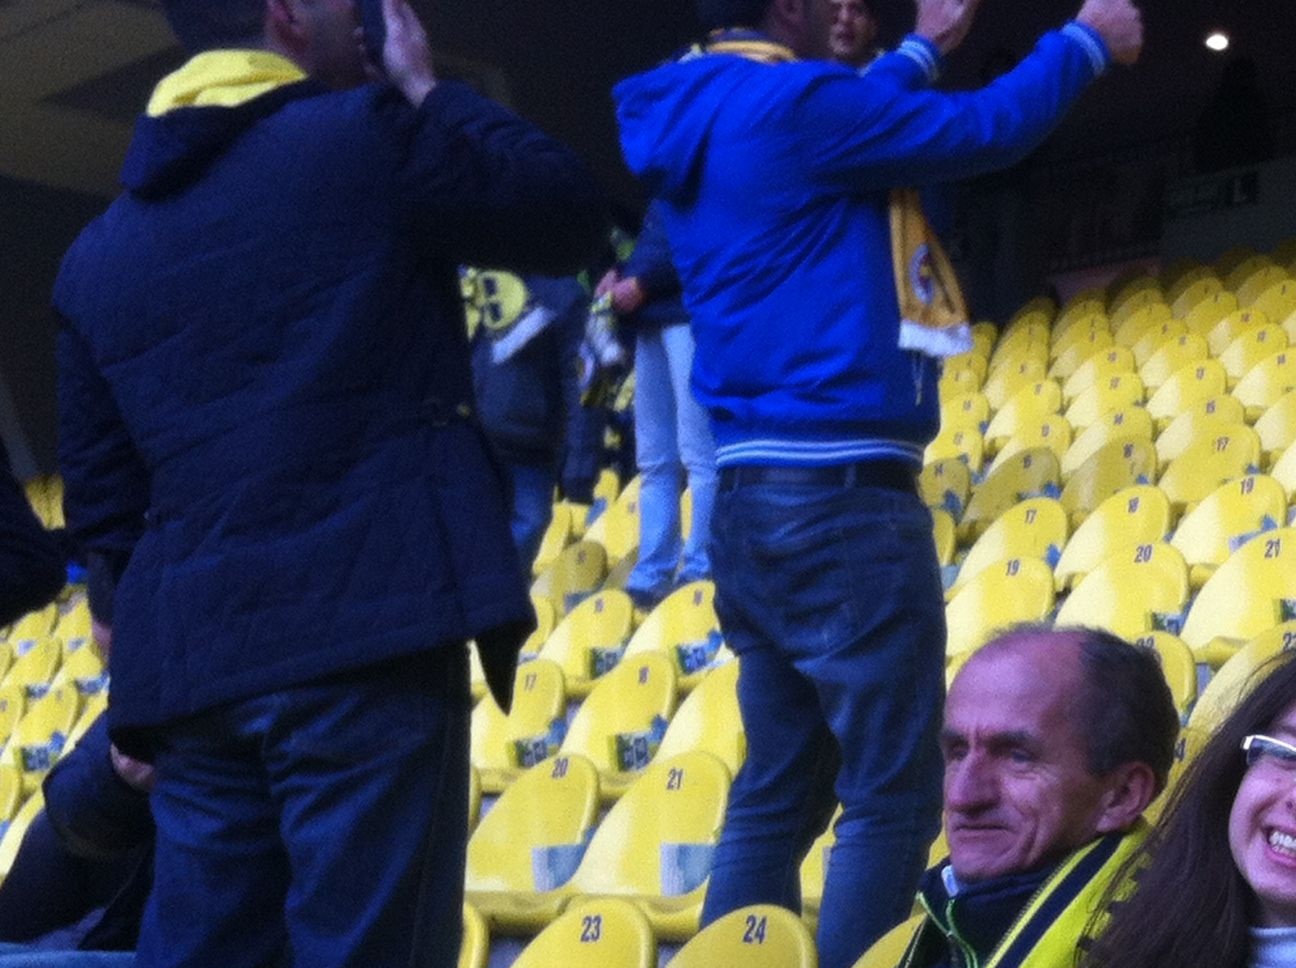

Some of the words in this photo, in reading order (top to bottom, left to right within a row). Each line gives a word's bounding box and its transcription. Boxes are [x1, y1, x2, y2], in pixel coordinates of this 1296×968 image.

[1133, 543, 1154, 563] 20
[1263, 537, 1283, 559] 21
[1005, 558, 1022, 576] 19
[666, 768, 684, 790] 21
[580, 914, 602, 942] 23
[742, 913, 769, 944] 24
